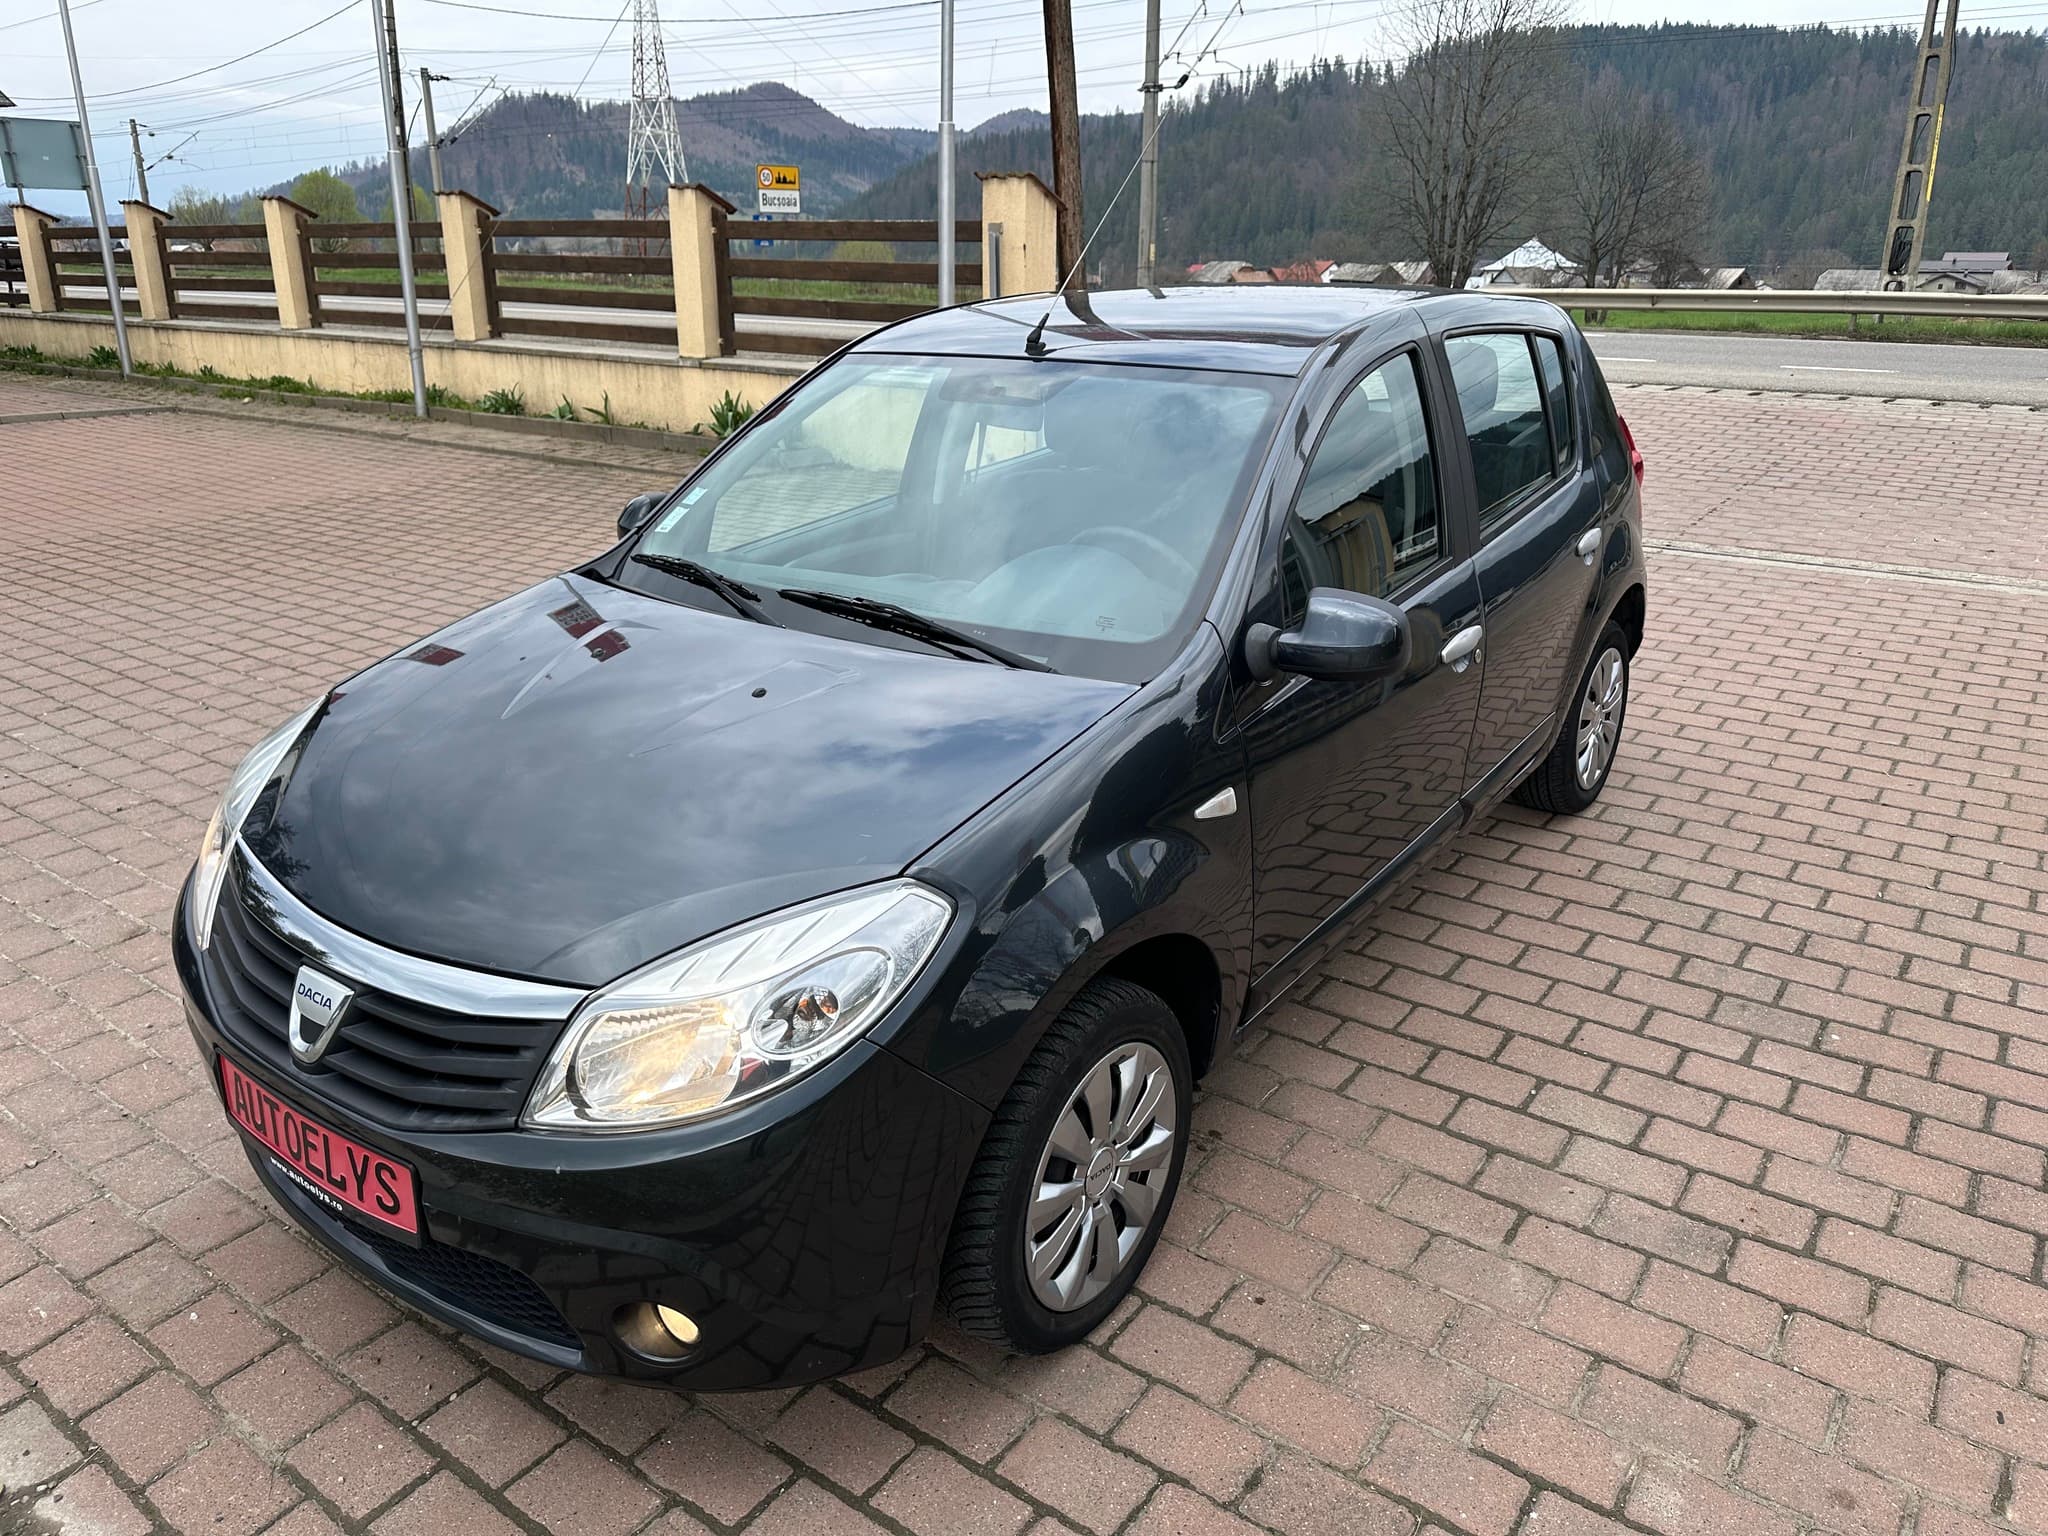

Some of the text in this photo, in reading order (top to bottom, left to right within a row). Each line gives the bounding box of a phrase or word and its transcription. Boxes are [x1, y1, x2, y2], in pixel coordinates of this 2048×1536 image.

[762, 172, 771, 182] 50
[298, 983, 332, 1011] DACIA
[233, 1071, 400, 1215] AUTOELYS
[270, 1156, 343, 1211] www.autoelys.ro
